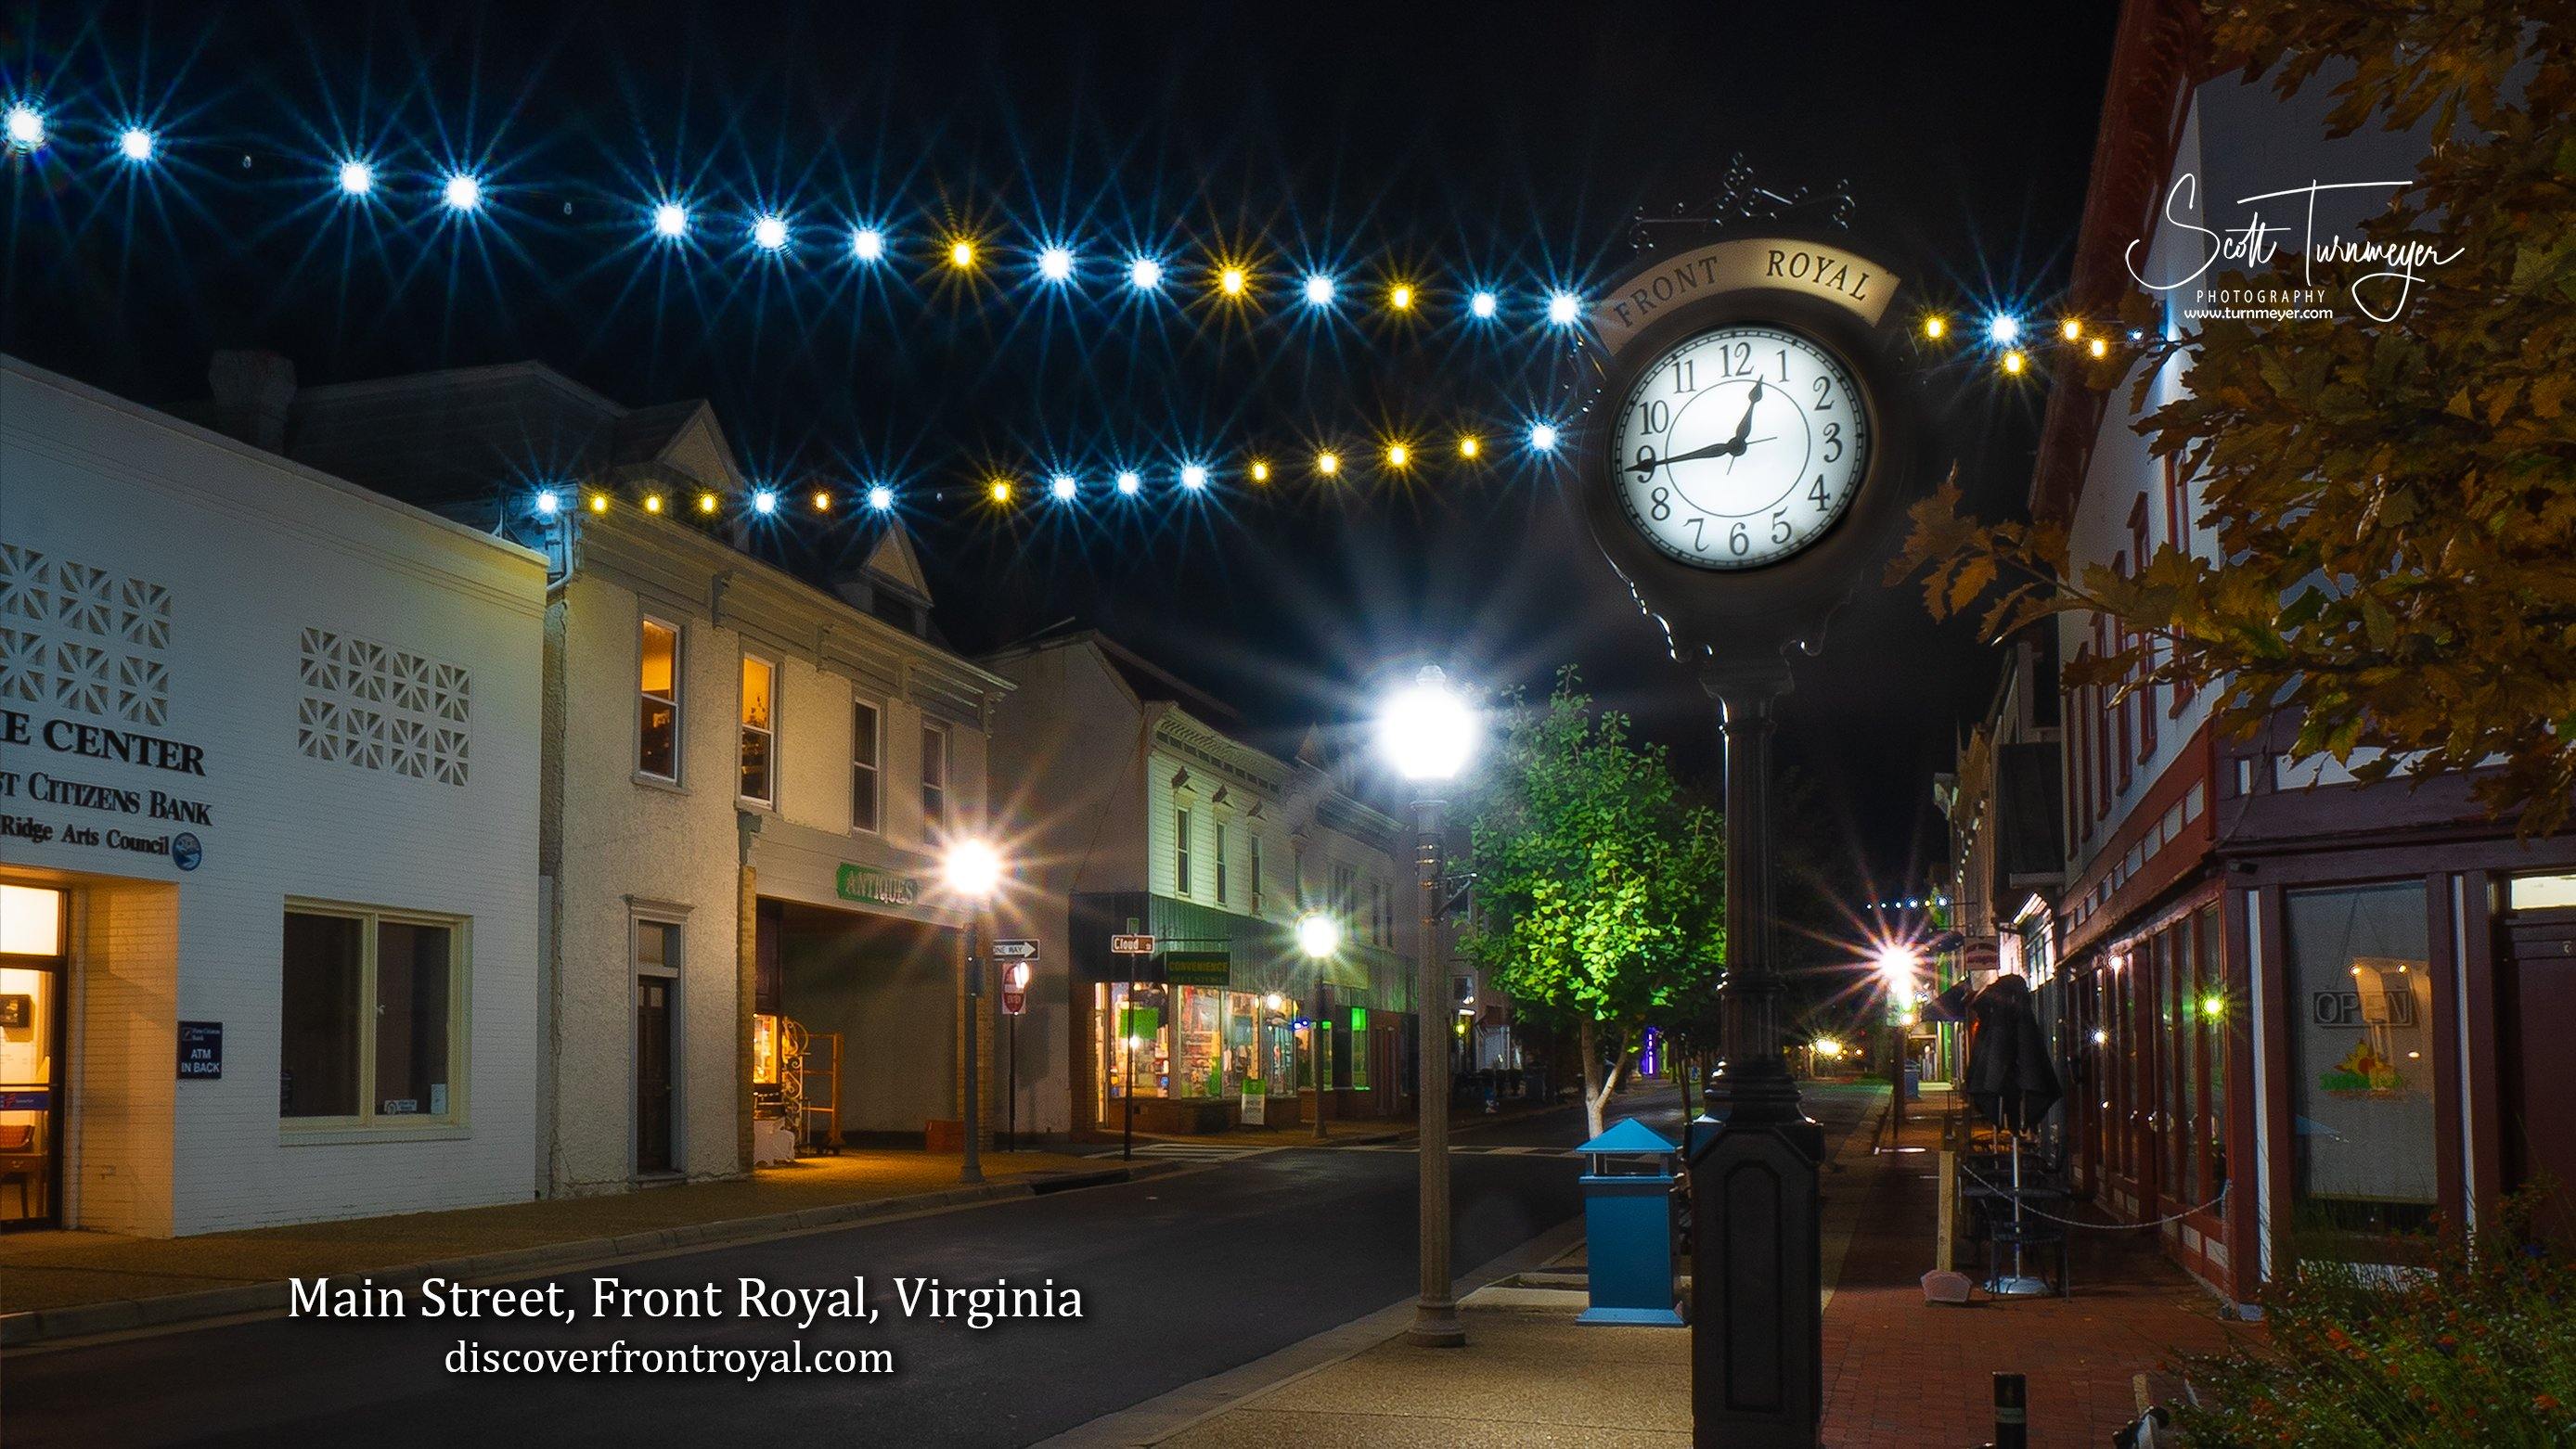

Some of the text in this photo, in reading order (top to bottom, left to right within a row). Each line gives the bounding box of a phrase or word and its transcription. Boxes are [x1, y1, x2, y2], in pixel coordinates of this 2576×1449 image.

[1614, 250, 1870, 327] FRONT ROYAL
[1671, 359, 1697, 393] 11
[1719, 341, 1755, 378] 12
[1776, 350, 1790, 382] 1
[1812, 376, 1835, 411] 2
[1640, 400, 1669, 435] 10
[1823, 422, 1843, 462] 3
[1636, 445, 1655, 483] 9
[1651, 487, 1670, 521] 8
[1808, 474, 1831, 512] 4
[1683, 518, 1709, 552] 7
[1729, 522, 1749, 556] 6
[1771, 507, 1792, 545] 5
[43, 719, 206, 776] CENTER
[28, 772, 140, 814] CITIZENS
[148, 789, 213, 826] BANK
[0, 814, 170, 855] Ridge Arts Council
[845, 870, 913, 904] ANTIQUES
[1114, 938, 1139, 950] Cloud
[1168, 961, 1229, 972] CONVENIENCE
[2316, 993, 2407, 1022] OPEN
[181, 1062, 220, 1073] IN BACK
[190, 1048, 212, 1059] ATM
